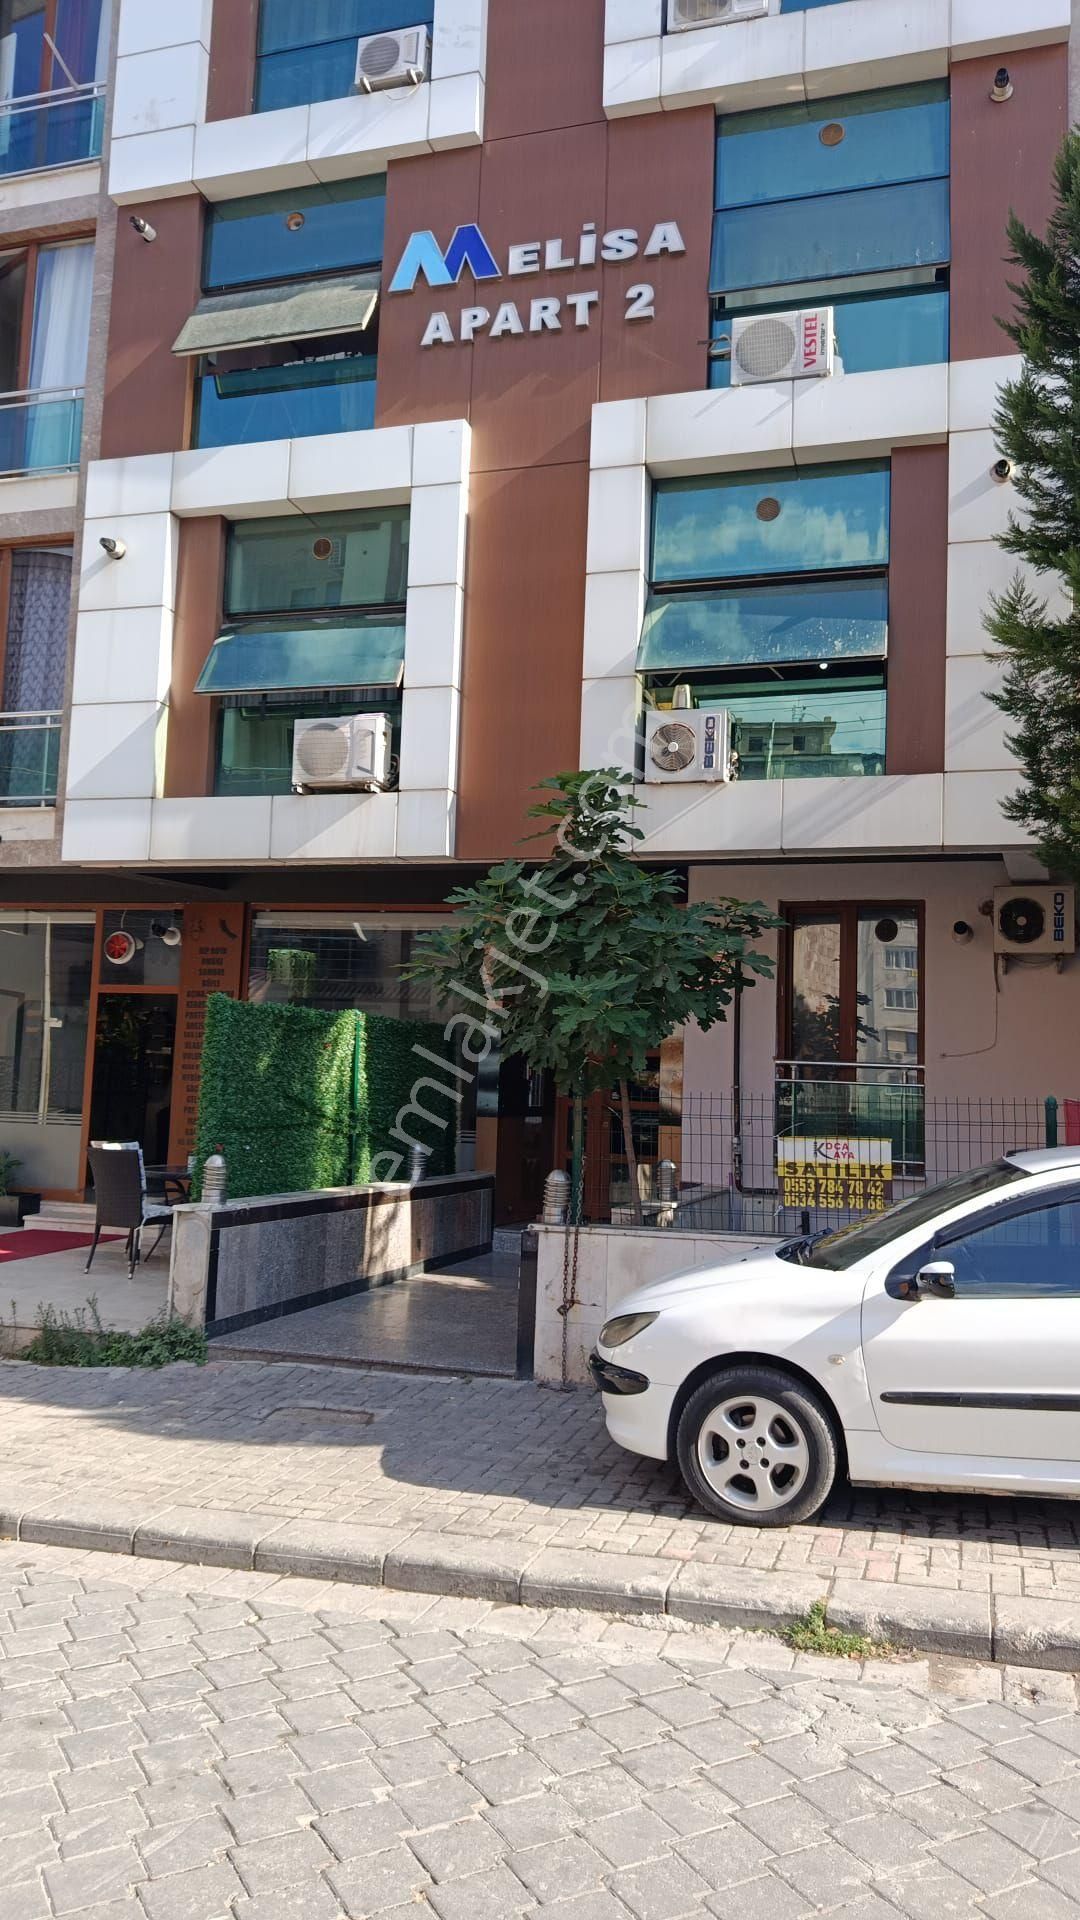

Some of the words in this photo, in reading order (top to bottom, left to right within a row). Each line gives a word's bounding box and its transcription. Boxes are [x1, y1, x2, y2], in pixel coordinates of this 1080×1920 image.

[420, 290, 599, 346] APART
[624, 283, 655, 320] 2
[803, 314, 818, 368] VESTEL
[704, 716, 715, 769] BEKO
[1053, 892, 1065, 942] BEKO
[784, 1178, 815, 1193] 0553
[818, 1179, 844, 1194] 784
[785, 1162, 884, 1178] SATILIK
[784, 1193, 816, 1208] 0534
